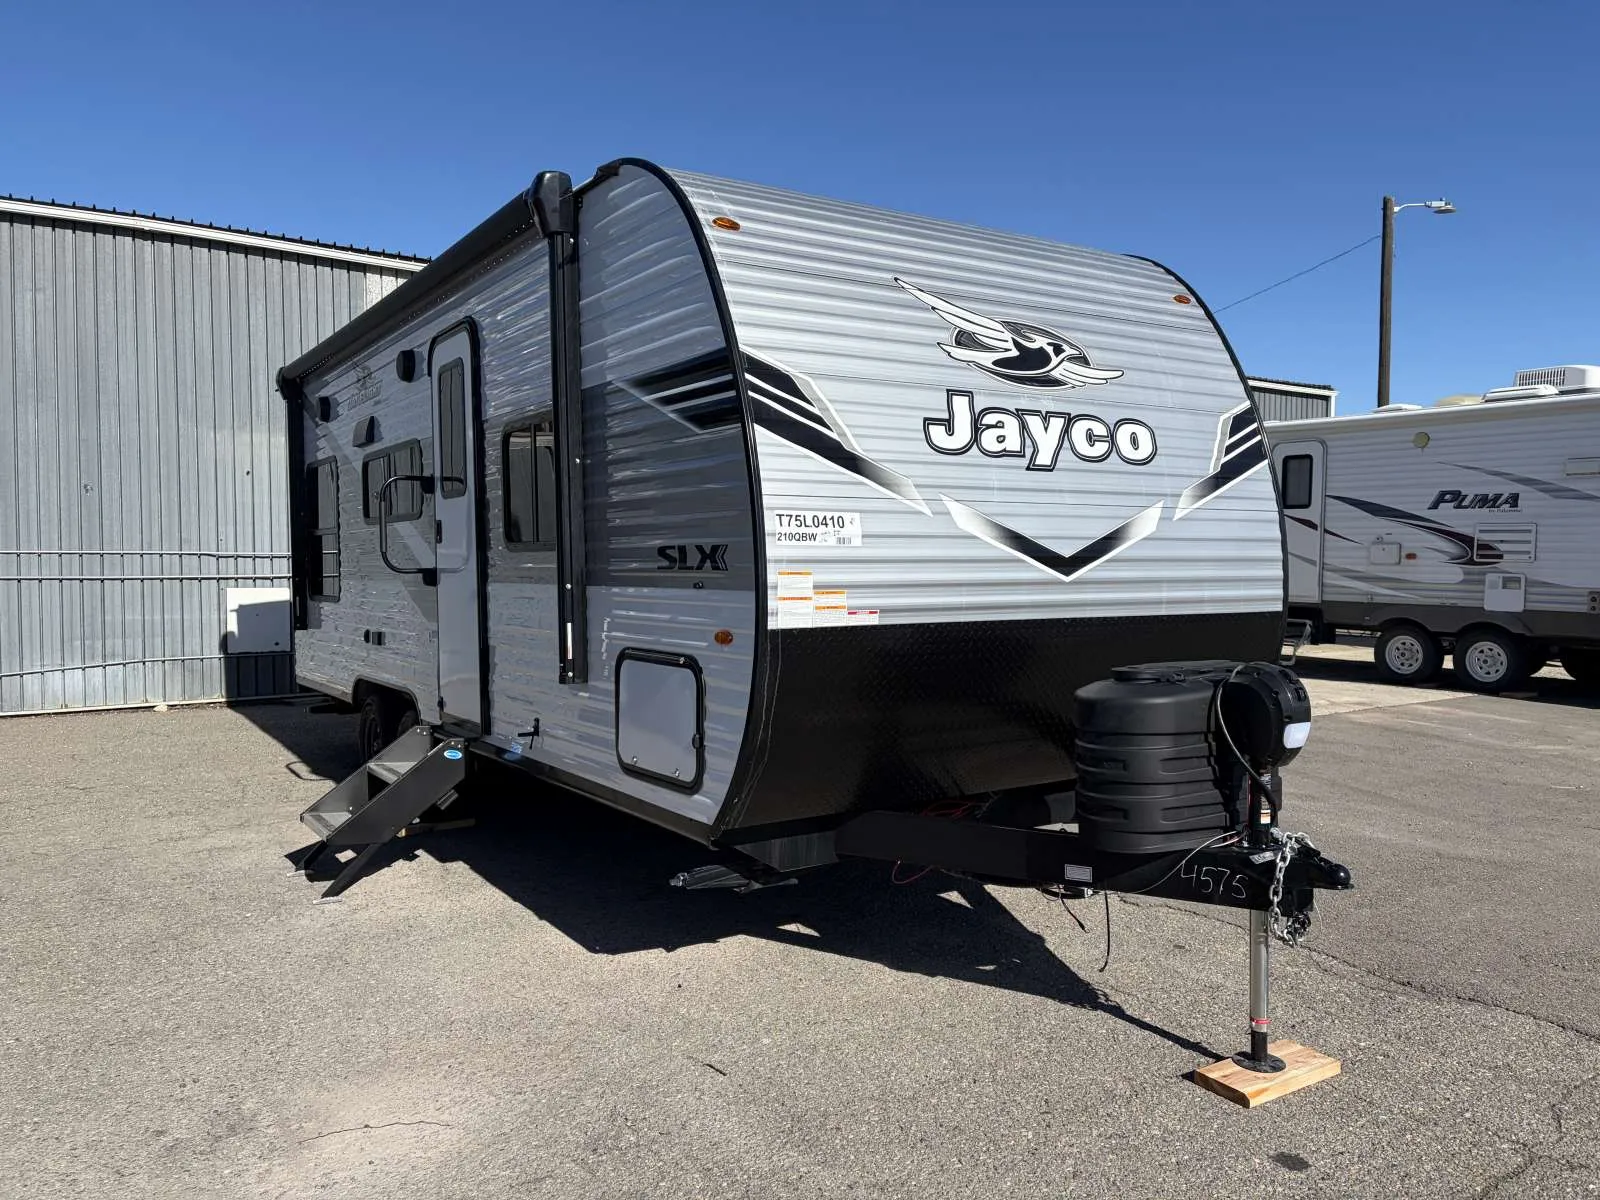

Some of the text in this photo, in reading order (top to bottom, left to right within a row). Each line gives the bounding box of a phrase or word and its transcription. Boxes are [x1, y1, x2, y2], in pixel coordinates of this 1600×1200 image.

[923, 389, 1158, 472] Jayco
[1427, 489, 1520, 510] PUMA
[775, 513, 845, 529] T75L0410
[777, 532, 818, 542] 210QBW
[656, 544, 728, 571] SLX
[1180, 862, 1248, 898] 4575
